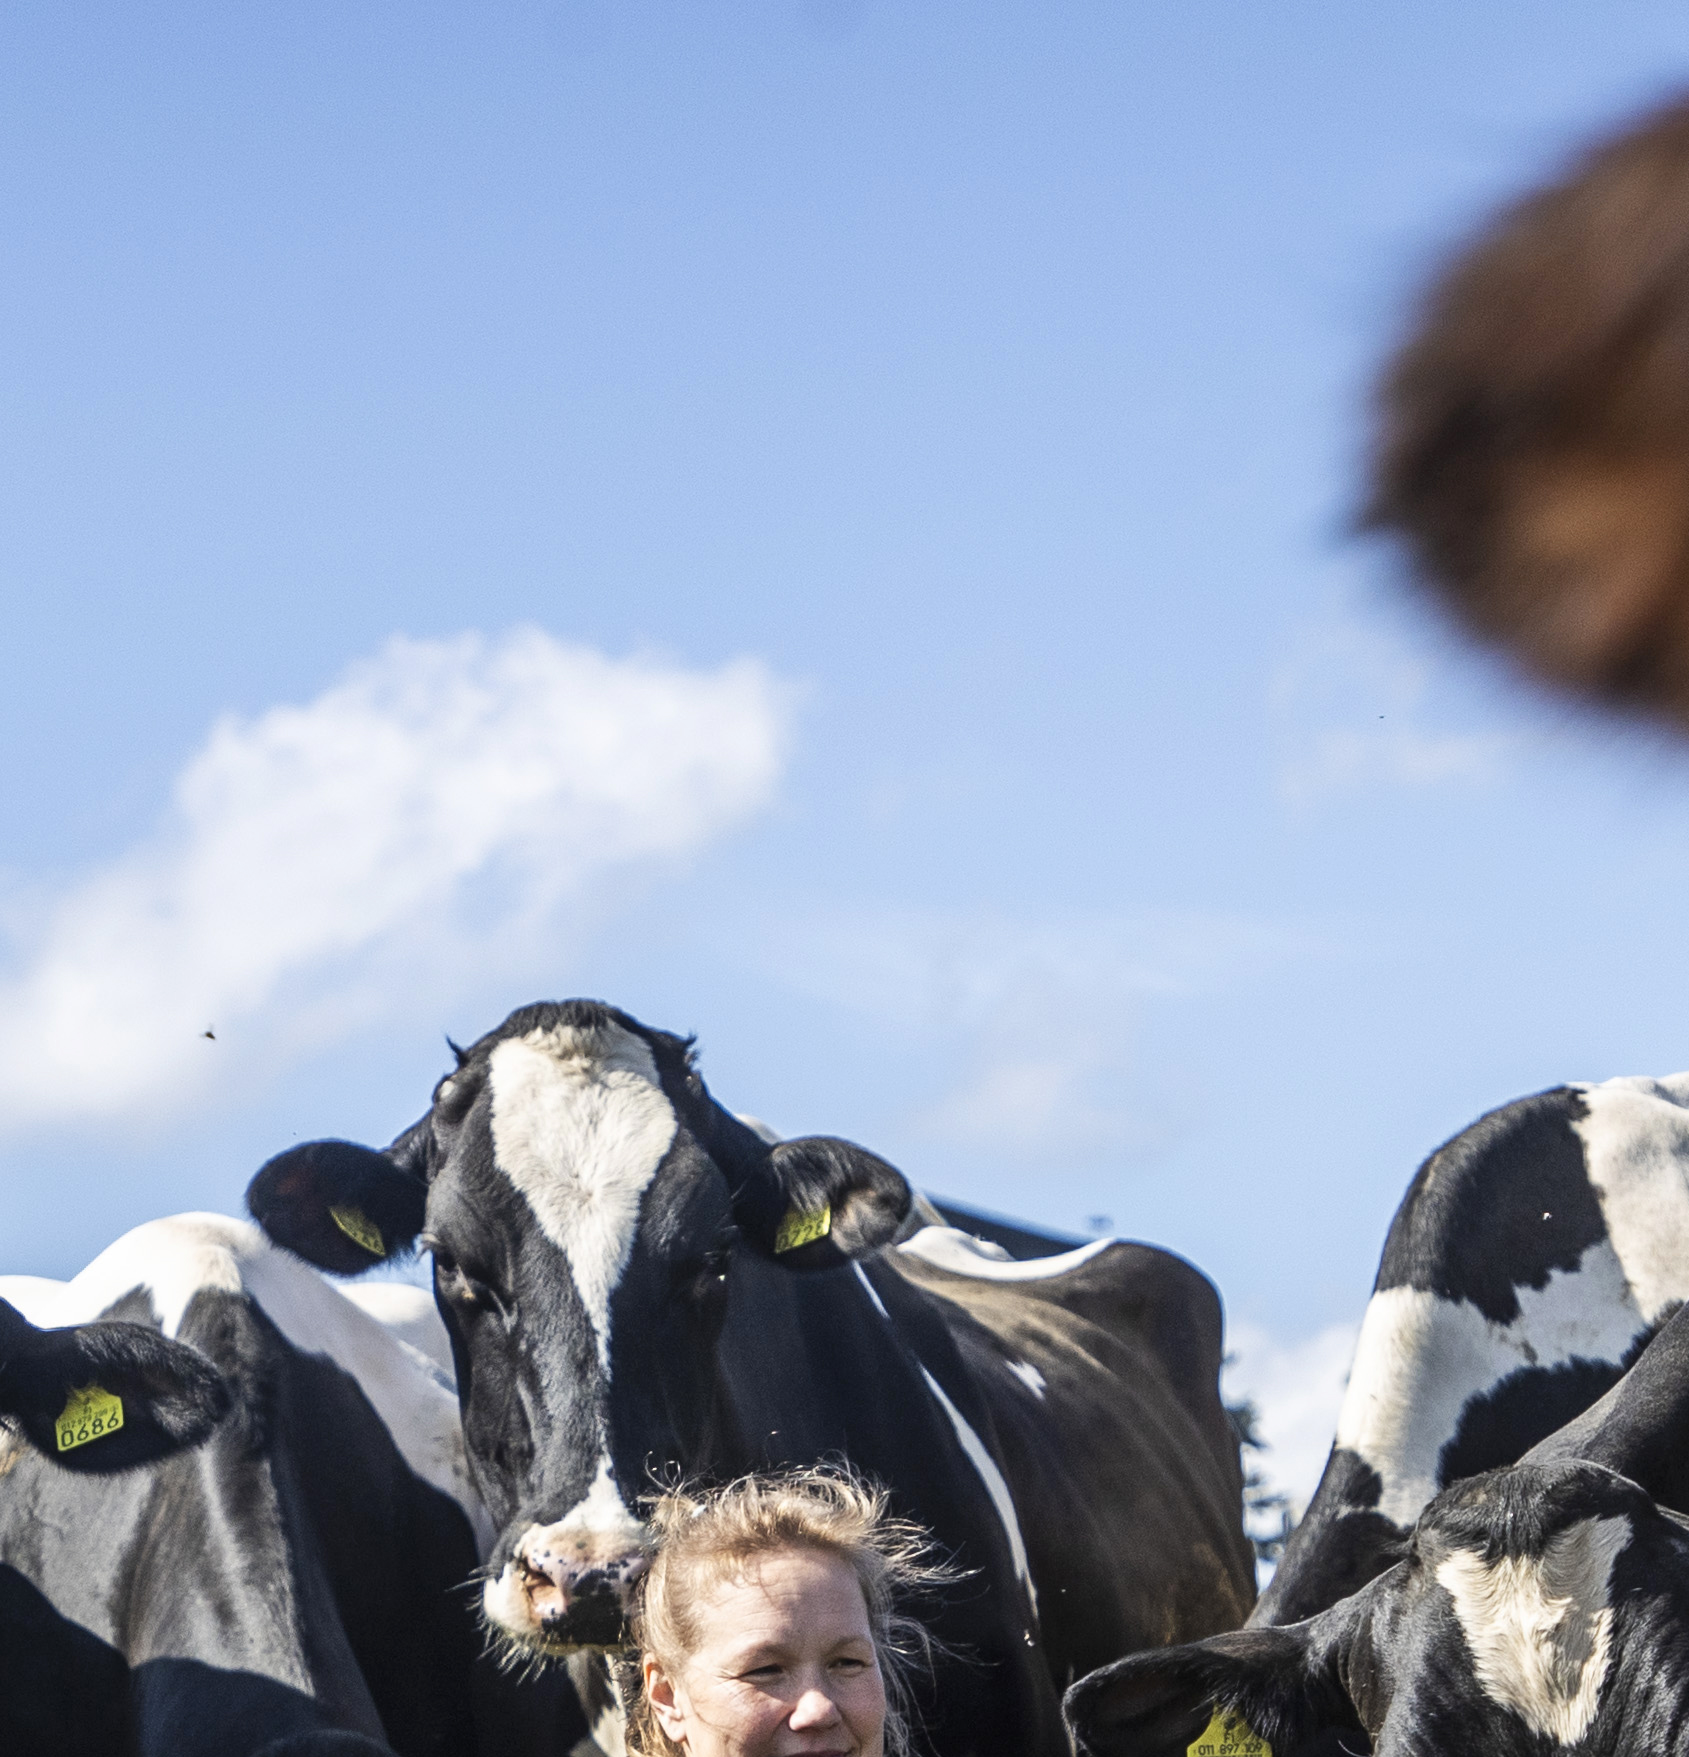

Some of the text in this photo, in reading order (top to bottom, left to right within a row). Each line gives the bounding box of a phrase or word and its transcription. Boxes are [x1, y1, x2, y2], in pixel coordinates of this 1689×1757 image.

[61, 1411, 119, 1447] 0686
[1198, 1744, 1215, 1755] 011
[1220, 1743, 1240, 1755] 897
